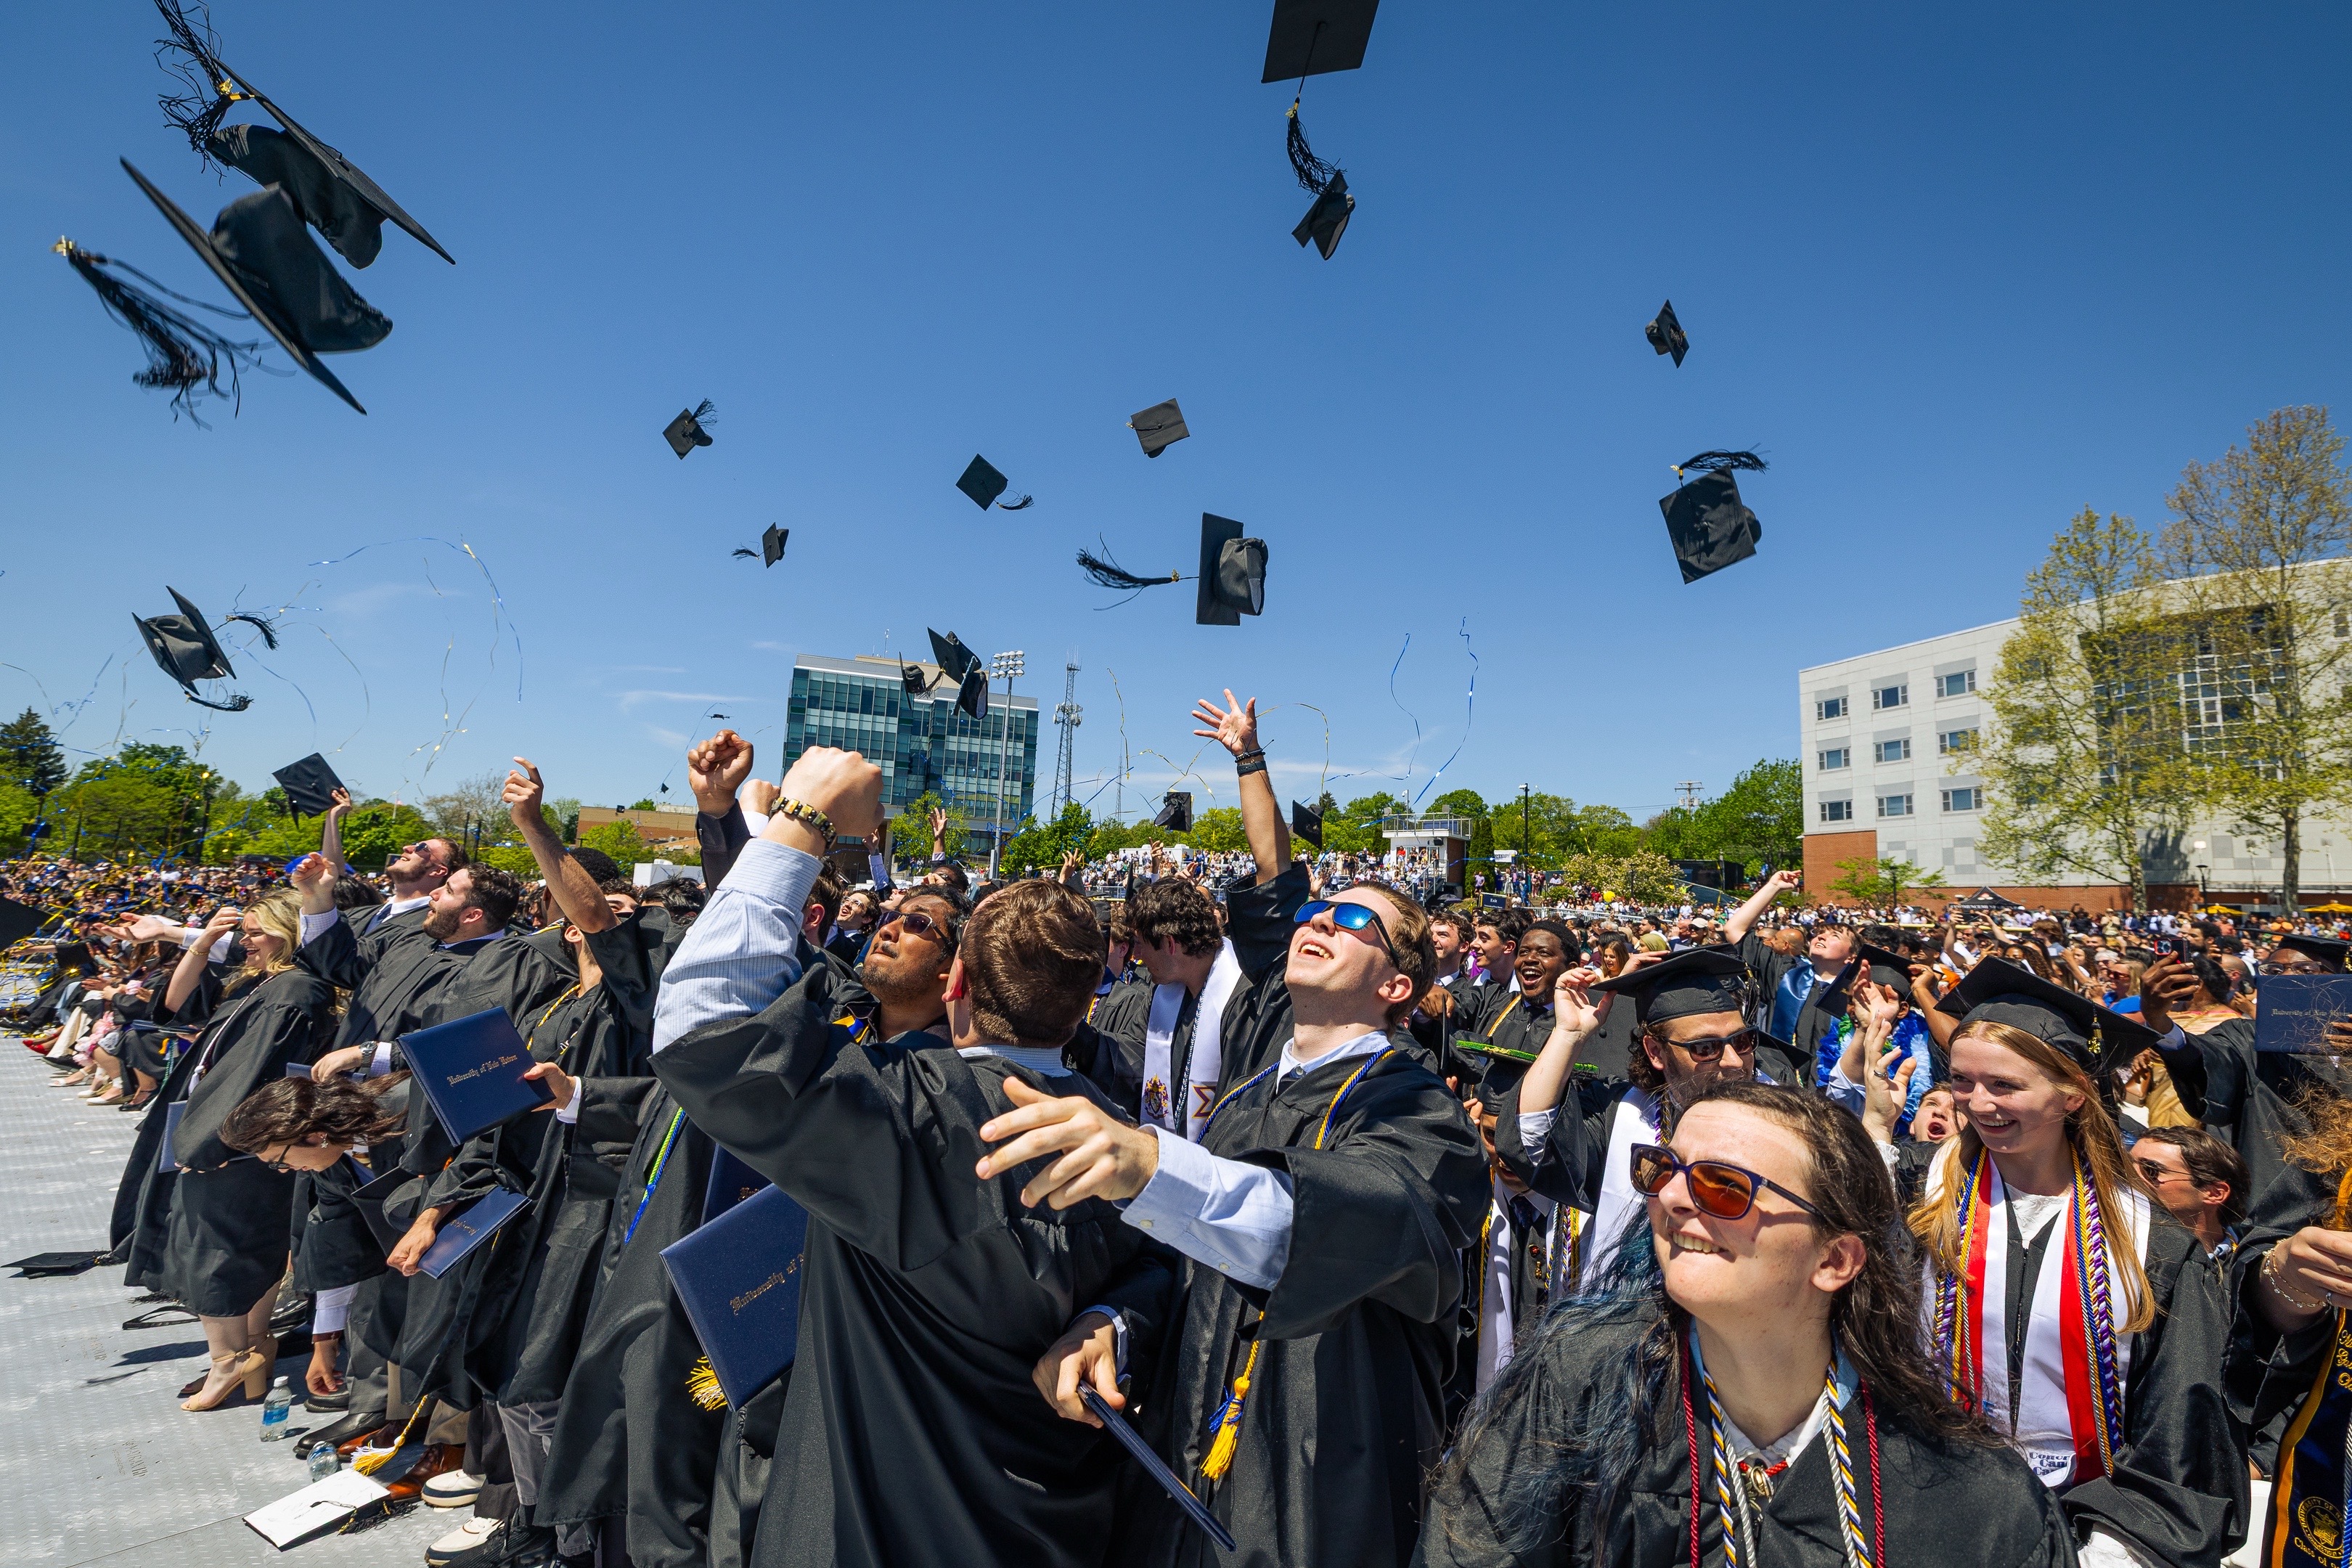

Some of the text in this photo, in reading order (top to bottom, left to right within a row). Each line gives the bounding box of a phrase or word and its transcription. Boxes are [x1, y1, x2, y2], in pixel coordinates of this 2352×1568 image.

[2271, 1008, 2303, 1017] University
[446, 1055, 518, 1087] University of New Haven
[730, 1272, 785, 1316] University
[786, 1258, 797, 1274] of
[2294, 1537, 2315, 1558] Class
[2318, 1556, 2327, 1567] of
